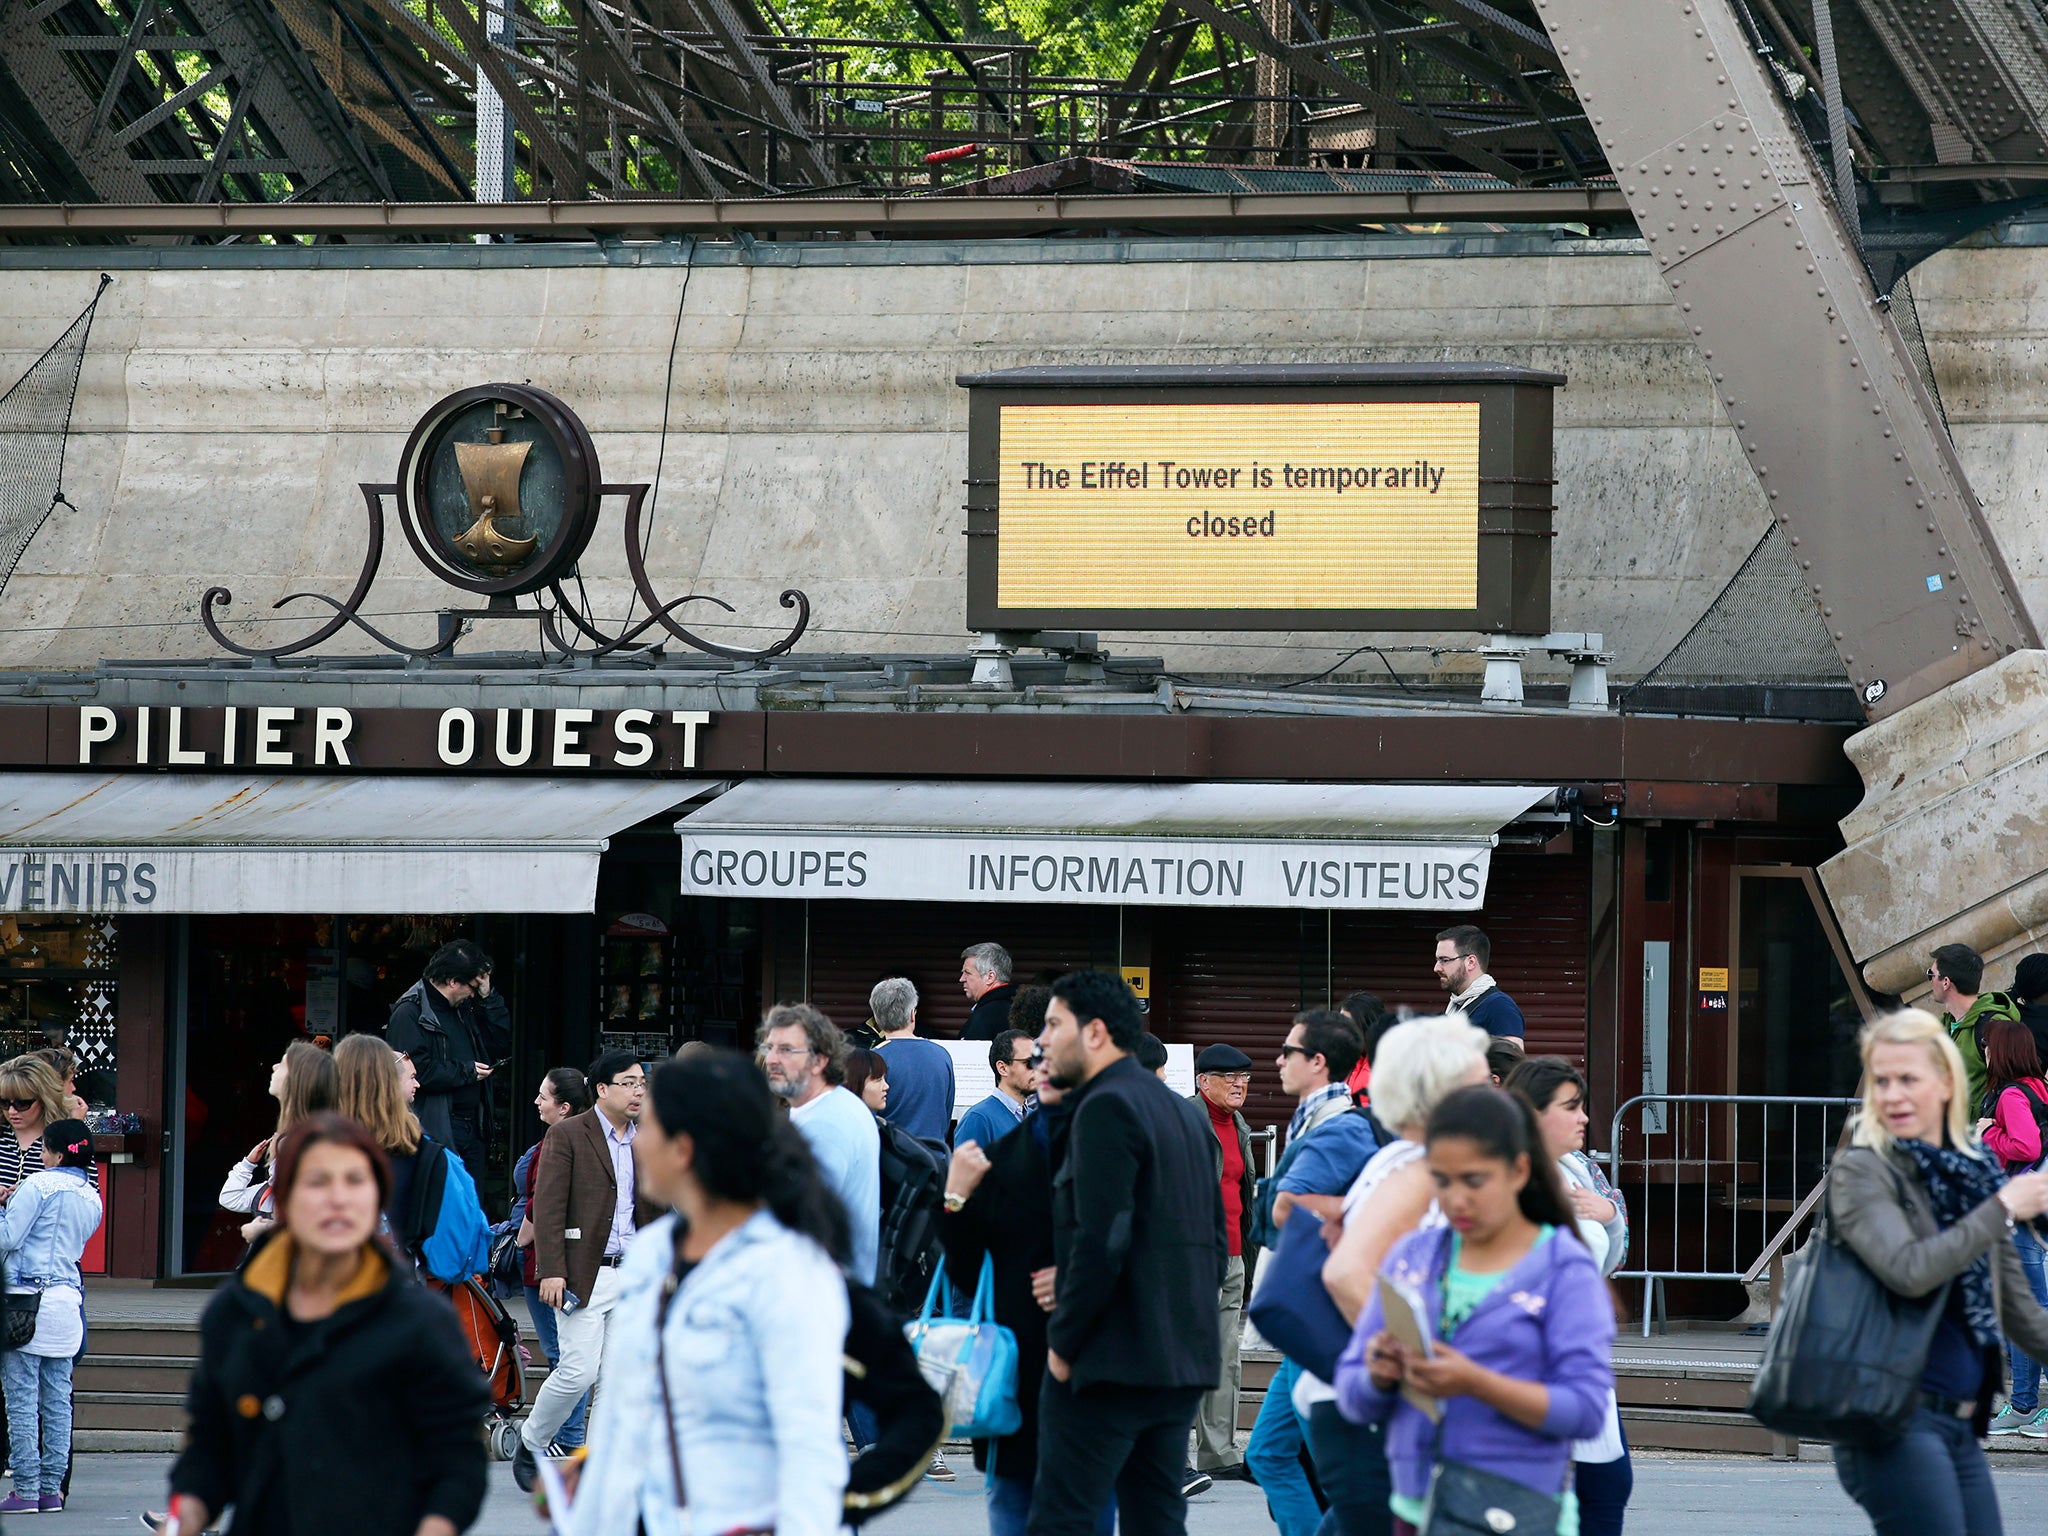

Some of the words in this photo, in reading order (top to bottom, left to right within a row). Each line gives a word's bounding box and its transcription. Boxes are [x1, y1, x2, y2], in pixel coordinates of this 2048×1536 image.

[1022, 462, 1070, 489] The
[1082, 462, 1148, 489] Eiffel
[1158, 462, 1241, 489] Tower
[1253, 462, 1273, 489] is
[1283, 461, 1445, 494] temporarily
[1187, 511, 1275, 538] closed
[80, 707, 353, 766] PILIER
[437, 707, 710, 768] OUEST
[691, 850, 867, 888] GROUPES
[967, 855, 1244, 897] INFORMATION
[1281, 860, 1482, 902] VISITEURS
